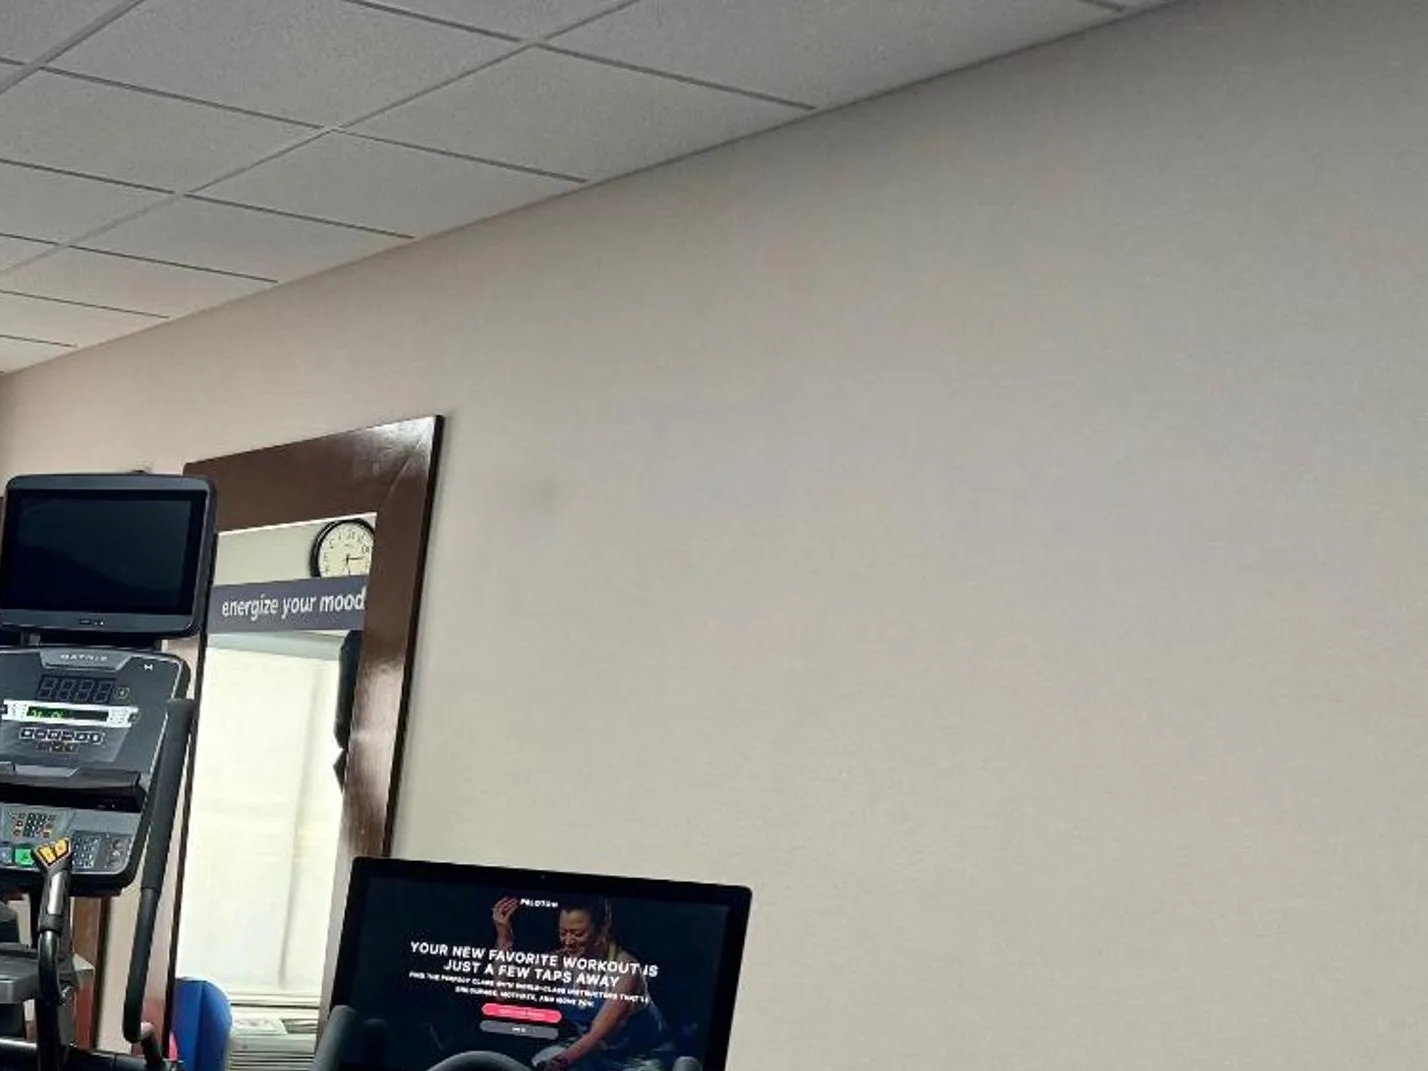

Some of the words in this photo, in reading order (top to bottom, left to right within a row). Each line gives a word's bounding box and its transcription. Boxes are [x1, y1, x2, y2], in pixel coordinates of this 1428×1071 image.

[222, 593, 279, 621] energize
[281, 596, 317, 619] your
[319, 586, 367, 613] mood
[410, 941, 449, 957] YOUR
[452, 945, 486, 960] NEW
[488, 949, 559, 967] FAVORITE
[563, 956, 641, 976] WORKOUT
[643, 964, 660, 978] IS
[443, 959, 482, 974] JUST
[483, 963, 494, 975] A
[497, 965, 531, 979] FEW
[534, 968, 573, 984] TAPS
[576, 973, 620, 988] AWAY
